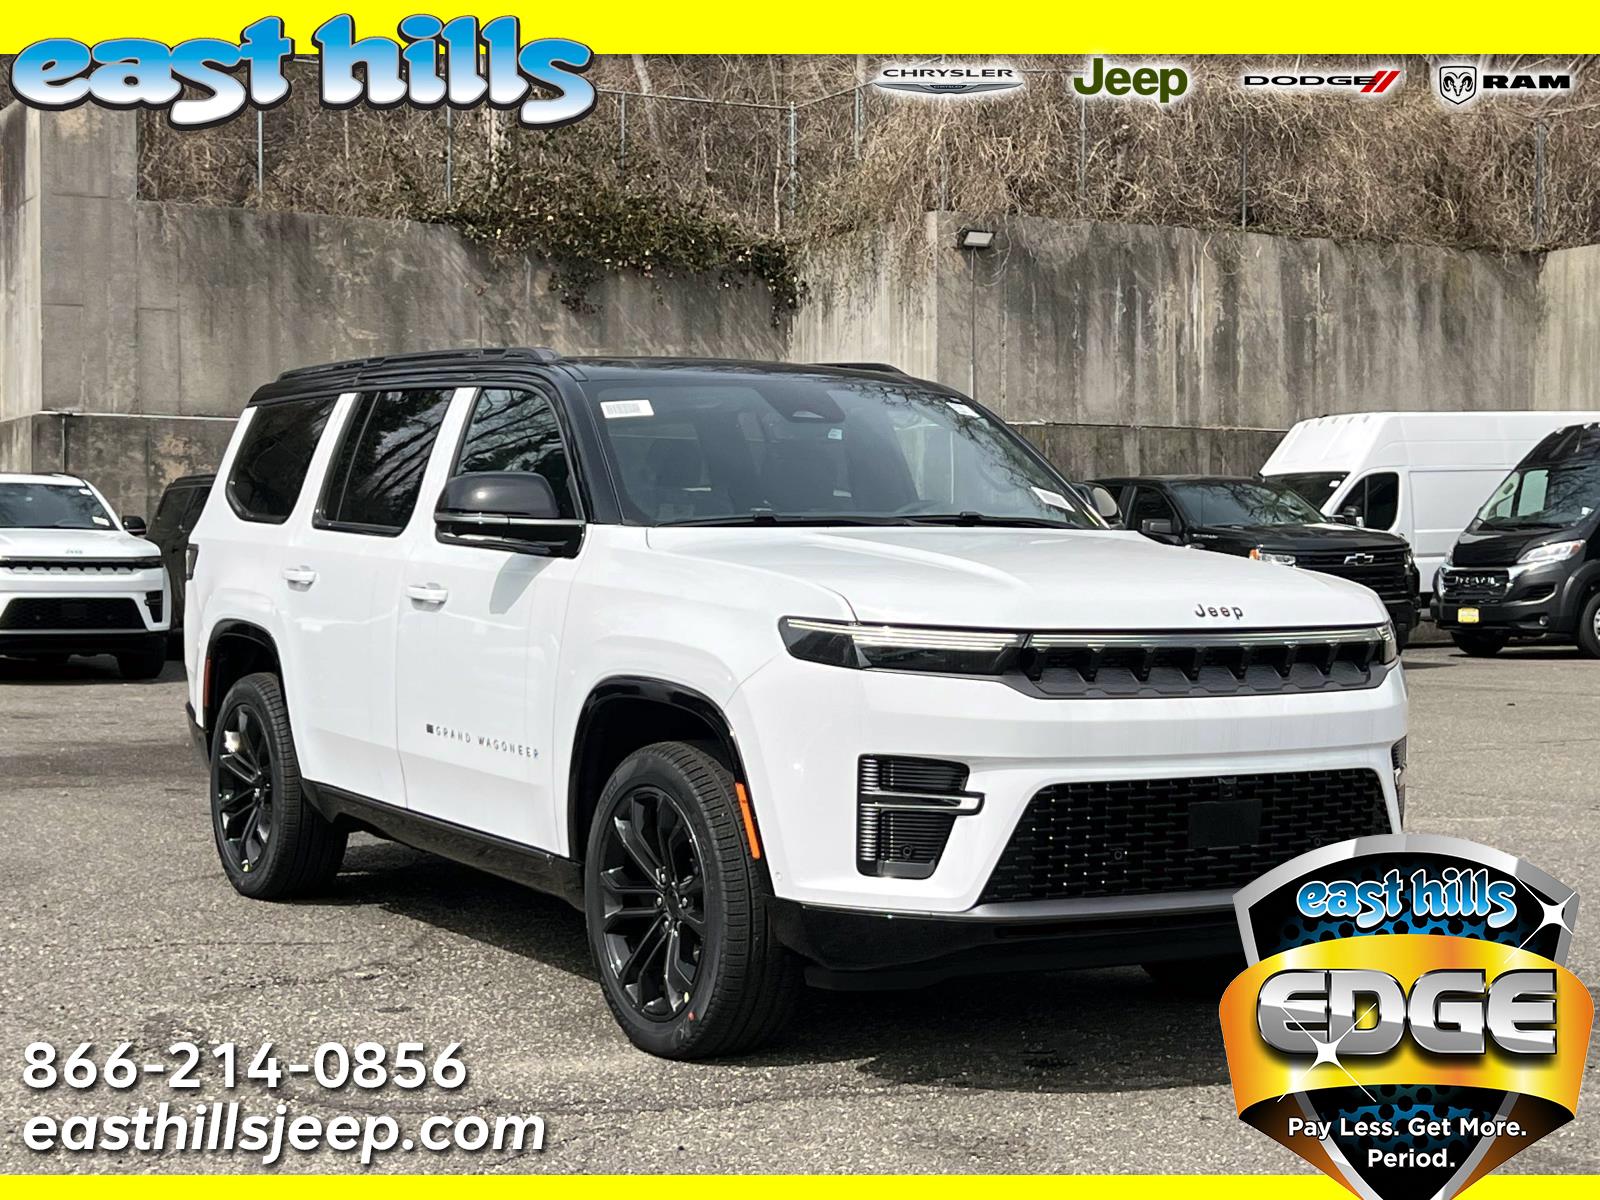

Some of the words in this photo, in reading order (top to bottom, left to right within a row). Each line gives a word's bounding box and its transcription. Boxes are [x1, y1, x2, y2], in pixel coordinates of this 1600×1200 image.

[1195, 603, 1244, 620] Jeep
[435, 726, 471, 743] GRAND
[478, 736, 538, 758] WAGONEER
